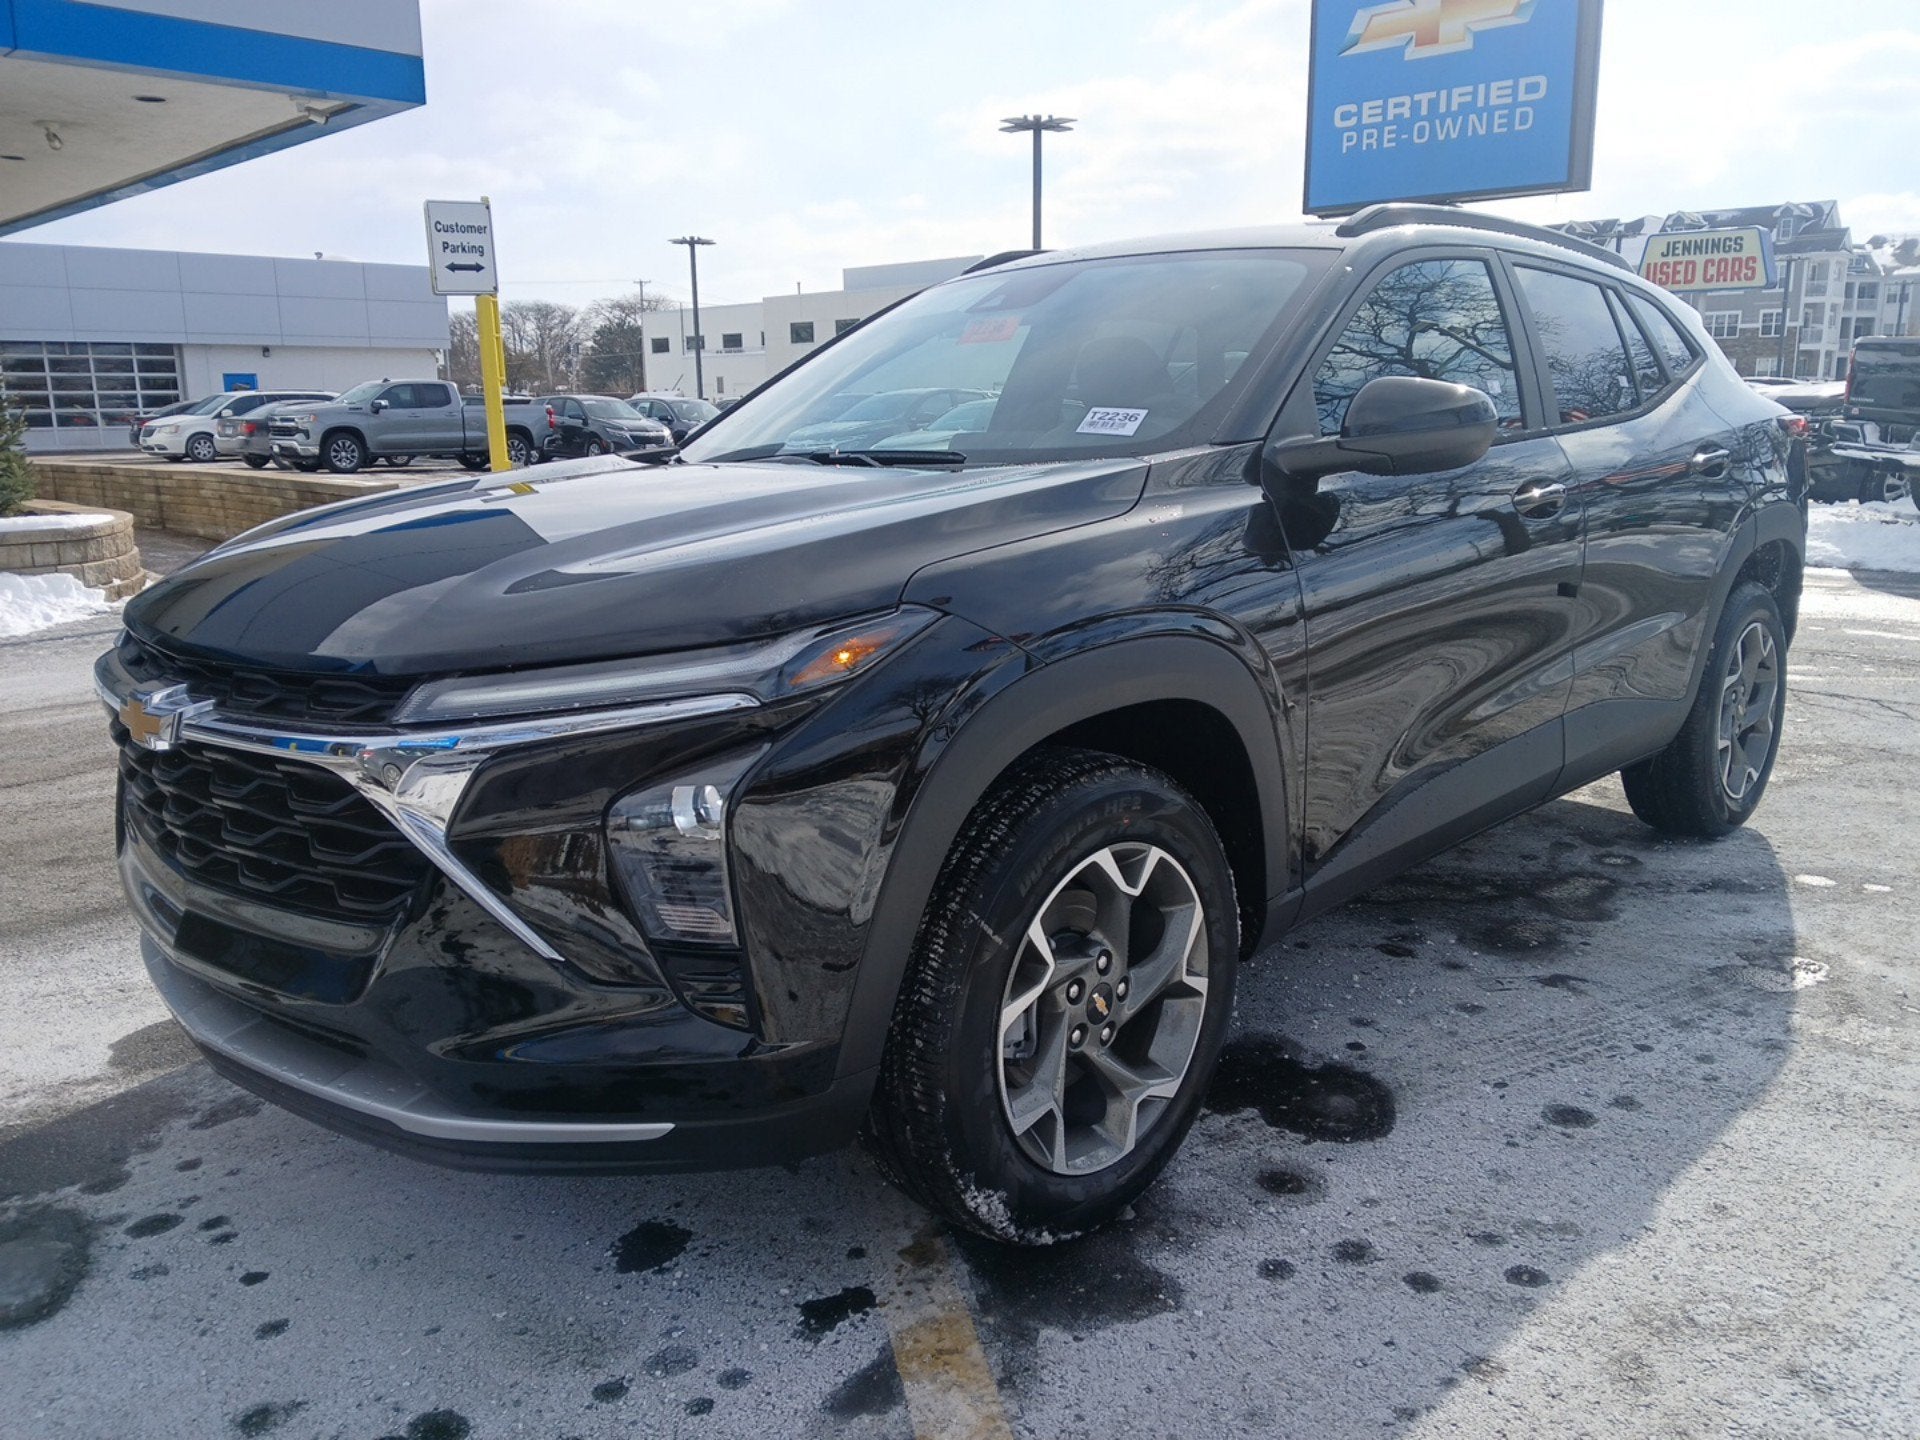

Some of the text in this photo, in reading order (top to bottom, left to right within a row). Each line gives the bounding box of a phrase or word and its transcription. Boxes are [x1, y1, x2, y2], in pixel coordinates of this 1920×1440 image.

[1334, 75, 1548, 128] CERTIFIED
[1342, 106, 1534, 154] PRE-OWNED
[434, 220, 487, 234] Customer
[442, 241, 485, 257] Parking
[1661, 236, 1744, 257] JENNINGS
[1645, 255, 1757, 286] USED CARS
[1089, 411, 1141, 422] T2236
